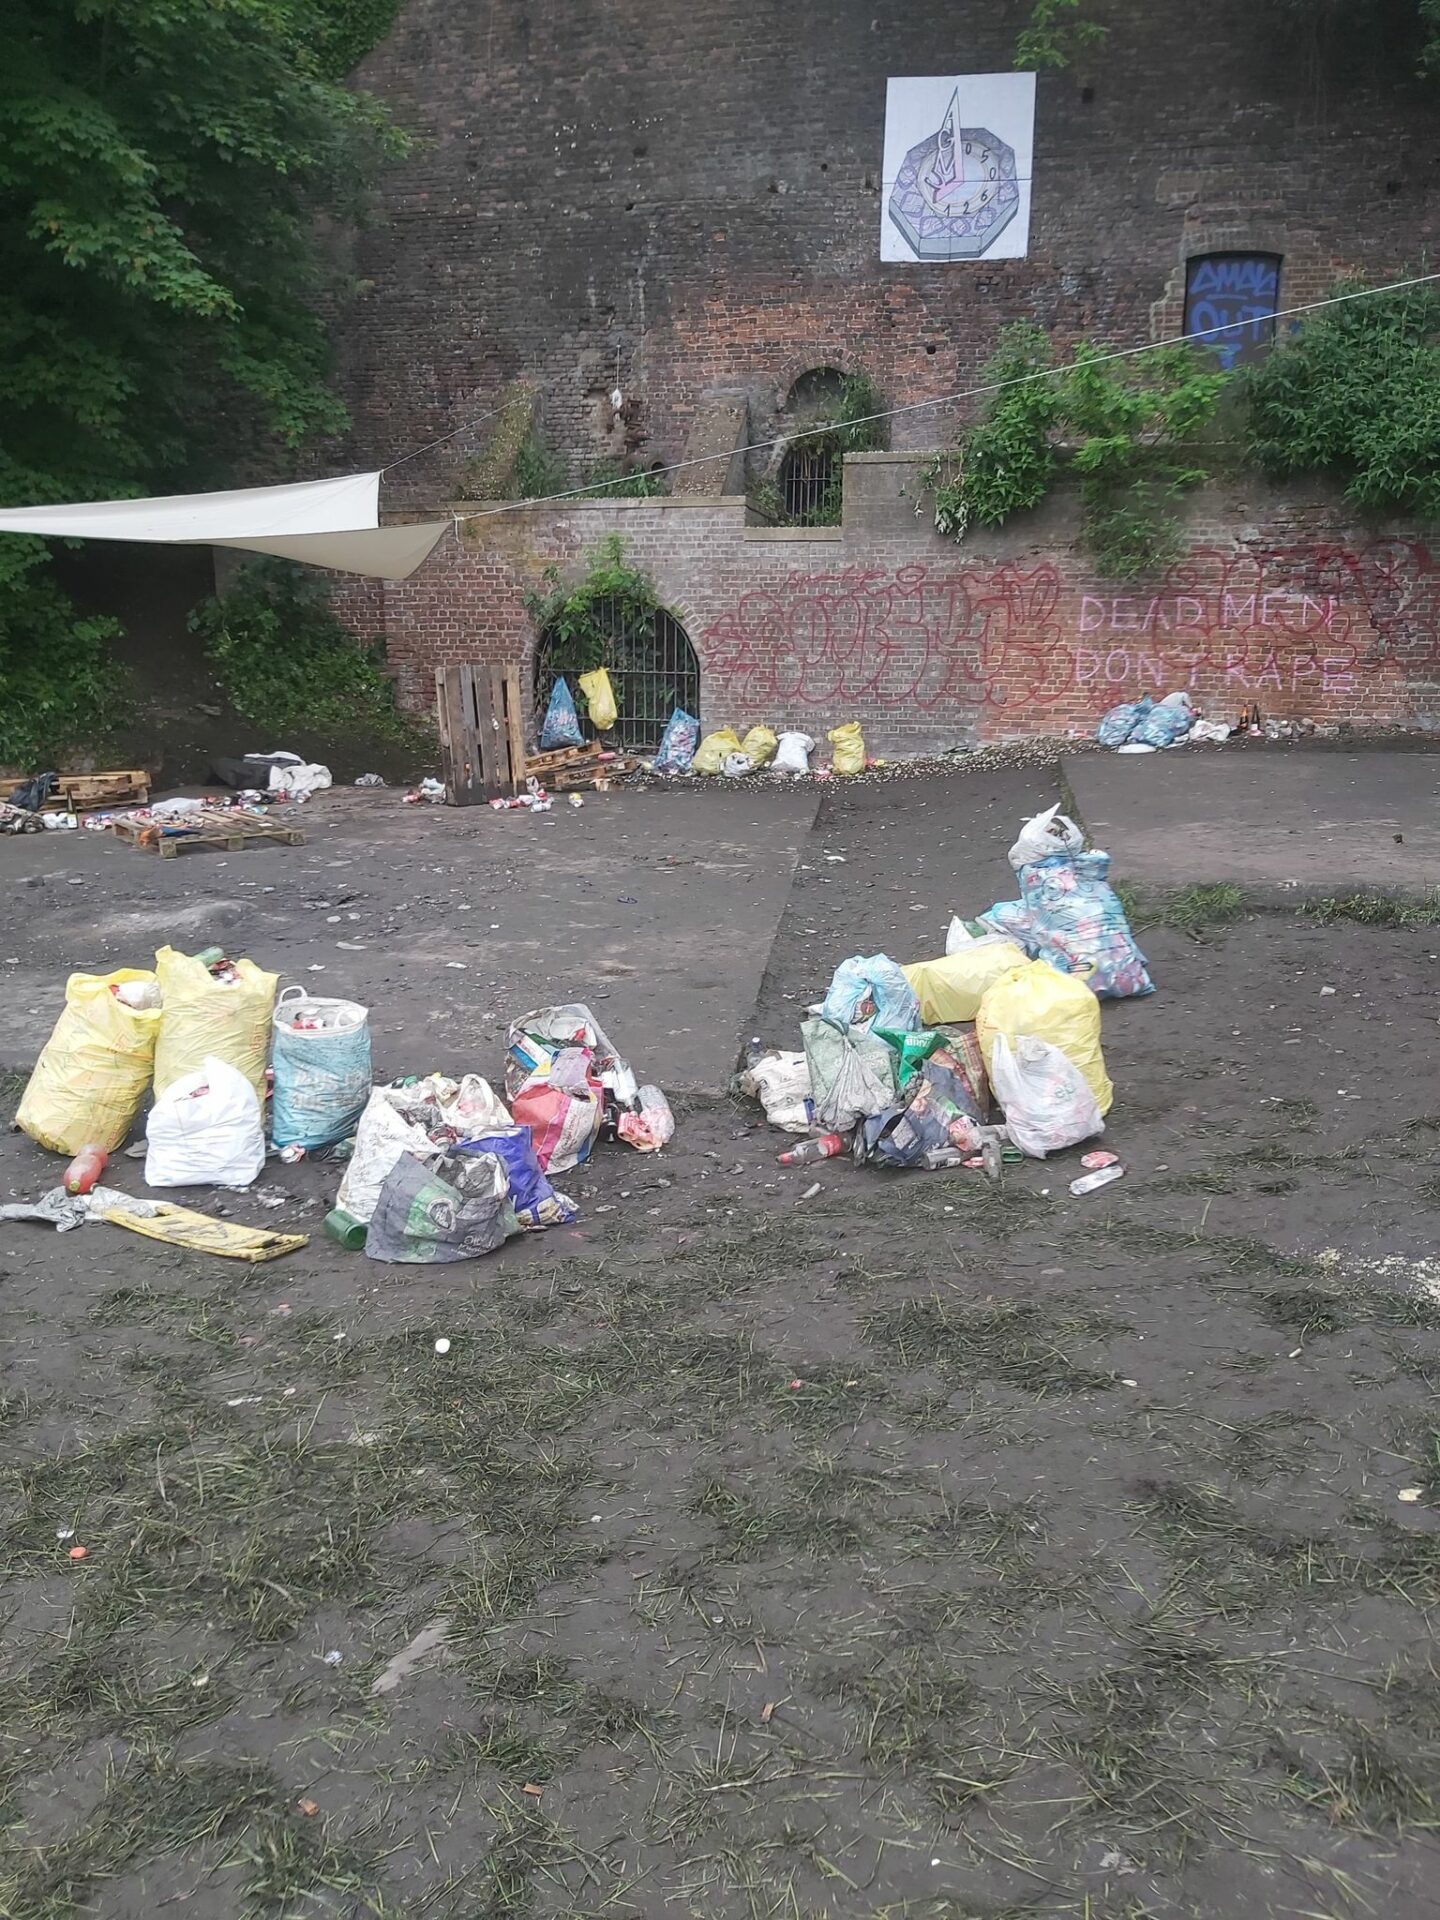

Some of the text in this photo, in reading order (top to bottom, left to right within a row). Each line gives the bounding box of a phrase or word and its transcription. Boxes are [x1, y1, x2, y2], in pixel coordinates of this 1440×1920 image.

[1190, 301, 1274, 342] OUT
[1078, 592, 1335, 632] DEAD MEN
[1226, 650, 1354, 693] RAPE
